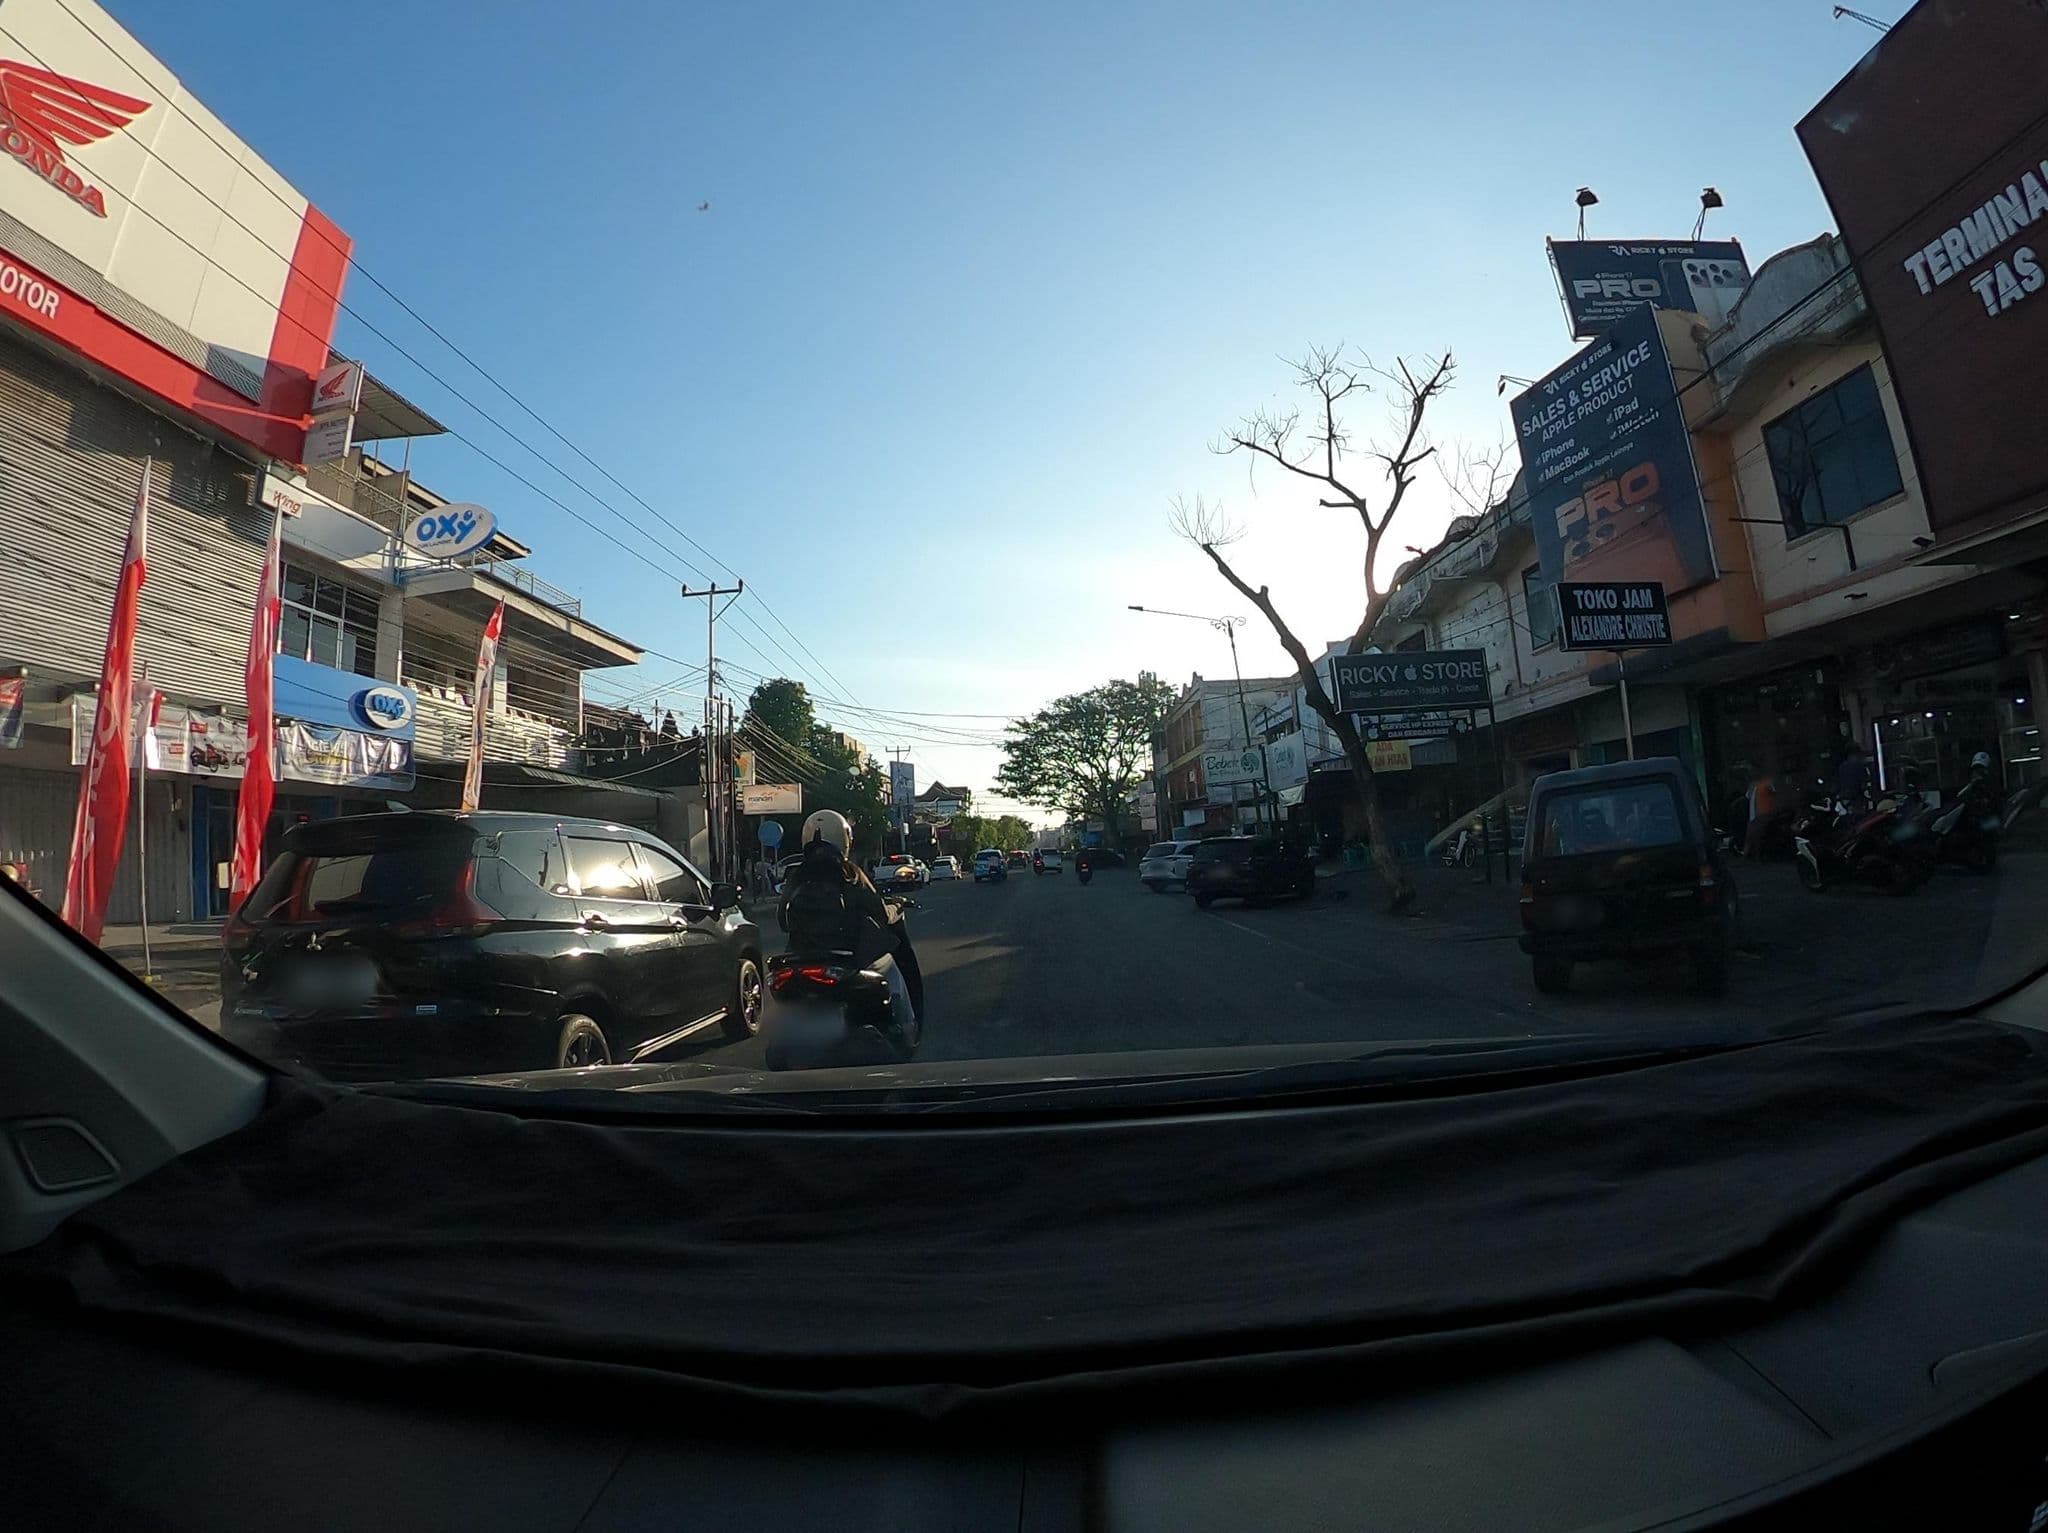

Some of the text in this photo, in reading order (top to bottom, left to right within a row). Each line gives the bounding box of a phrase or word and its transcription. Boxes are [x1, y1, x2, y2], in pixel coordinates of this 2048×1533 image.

[0, 126, 108, 218] ONDA
[0, 261, 60, 319] OTOR
[1573, 279, 1661, 298] PRO
[1969, 246, 2046, 317] TAS
[1588, 343, 1613, 364] STORE
[1522, 340, 1651, 437] SALES & SERVICE
[1541, 374, 1634, 442] APPLE PRODUCT
[1613, 396, 1639, 420] iPad
[1541, 438, 1575, 463] iPhone
[1544, 447, 1590, 480] MacBook
[272, 490, 301, 514] Wing
[1555, 461, 1660, 538] PRO
[1573, 589, 1654, 610] TOKO JAM
[1571, 614, 1667, 641] ALEXANDRE CHRISTIE
[1340, 661, 1483, 685] RICKY STORE
